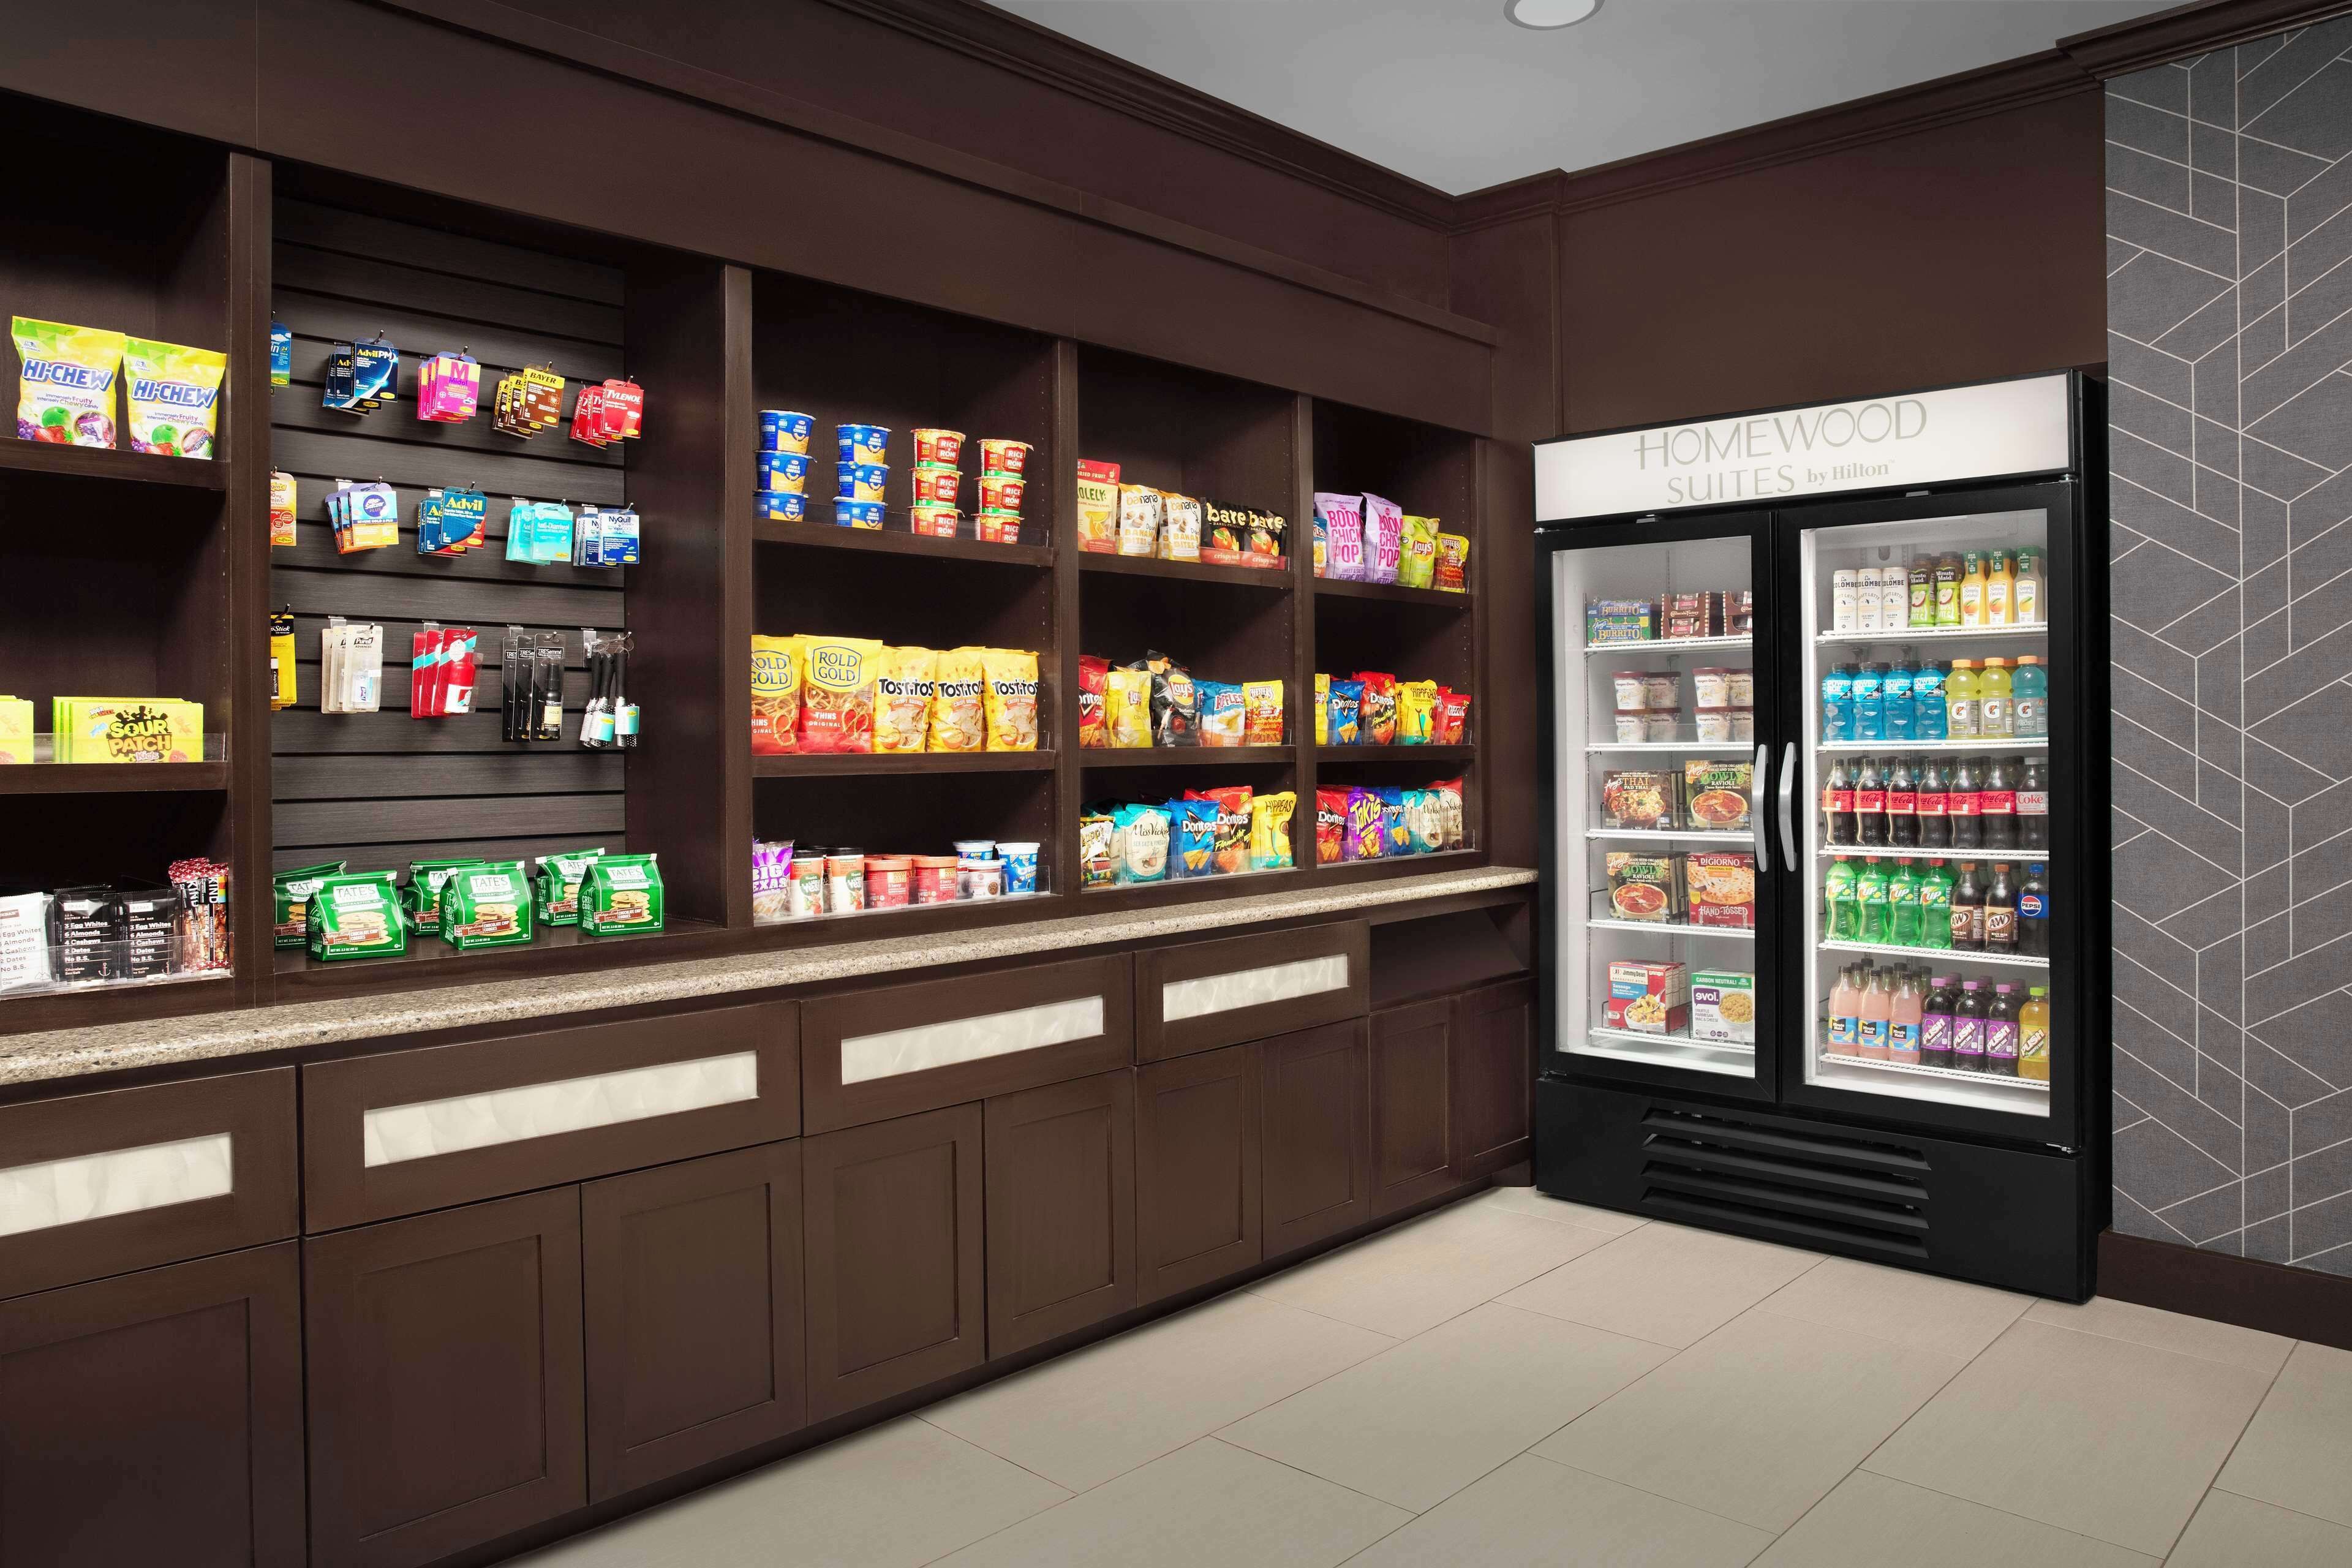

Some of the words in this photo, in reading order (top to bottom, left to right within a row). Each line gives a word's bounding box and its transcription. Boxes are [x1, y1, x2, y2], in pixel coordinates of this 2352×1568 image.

[357, 349, 379, 358] Advil
[379, 351, 393, 360] PM
[23, 359, 113, 391] HI-CHEW
[530, 372, 557, 384] BAYER
[45, 393, 71, 401] Immensely
[132, 378, 217, 409] HI-CHEW
[606, 389, 642, 402] TYLENOL
[59, 399, 84, 409] Chewy
[167, 417, 190, 426] Chewy
[1634, 399, 1928, 470] HOMEWOOD
[941, 440, 957, 449] RICE
[1008, 450, 1023, 459] RICE
[1667, 464, 1796, 505] SUITES
[1807, 468, 1828, 486] by
[445, 496, 483, 511] Advil
[1205, 502, 1246, 526] bare
[1248, 510, 1284, 529] bare
[1005, 524, 1019, 533] RICE
[1332, 544, 1359, 564] POP
[1414, 541, 1432, 555] Lay's
[1379, 549, 1400, 568] POP
[1601, 606, 1640, 617] BURRITO
[1599, 628, 1640, 640] BURRITO
[819, 652, 858, 667] ROLD
[818, 666, 856, 682] GOLD
[1170, 682, 1194, 698] Lay's
[1333, 699, 1359, 709] Doritos
[1370, 693, 1395, 705] Doritos
[1951, 701, 1967, 720] G
[1984, 701, 2000, 718] G
[2017, 702, 2032, 718] G
[110, 720, 168, 738] SOUR
[108, 735, 172, 756] PATCH
[135, 751, 159, 761] Kids
[1686, 763, 1708, 778] Amy's
[1605, 778, 1623, 793] Amy's
[1265, 799, 1293, 813] HIPPEAS
[2018, 794, 2043, 804] Coke
[1217, 813, 1248, 825] Doritos
[1318, 811, 1345, 825] Doritos
[1350, 797, 1382, 835] Takis
[1132, 824, 1150, 837] Miss
[1183, 820, 1217, 832] Doritos
[1608, 855, 1629, 869] Amy's
[1700, 858, 1740, 866] DIGIORNO
[609, 867, 643, 877] TATE'S
[753, 864, 783, 882] BIG
[472, 875, 508, 887] TATE'S
[208, 877, 219, 903] KIND
[336, 886, 376, 897] TATE'S
[1698, 905, 1748, 917] HAND-TOSSED
[1695, 992, 1719, 1002] evol.
